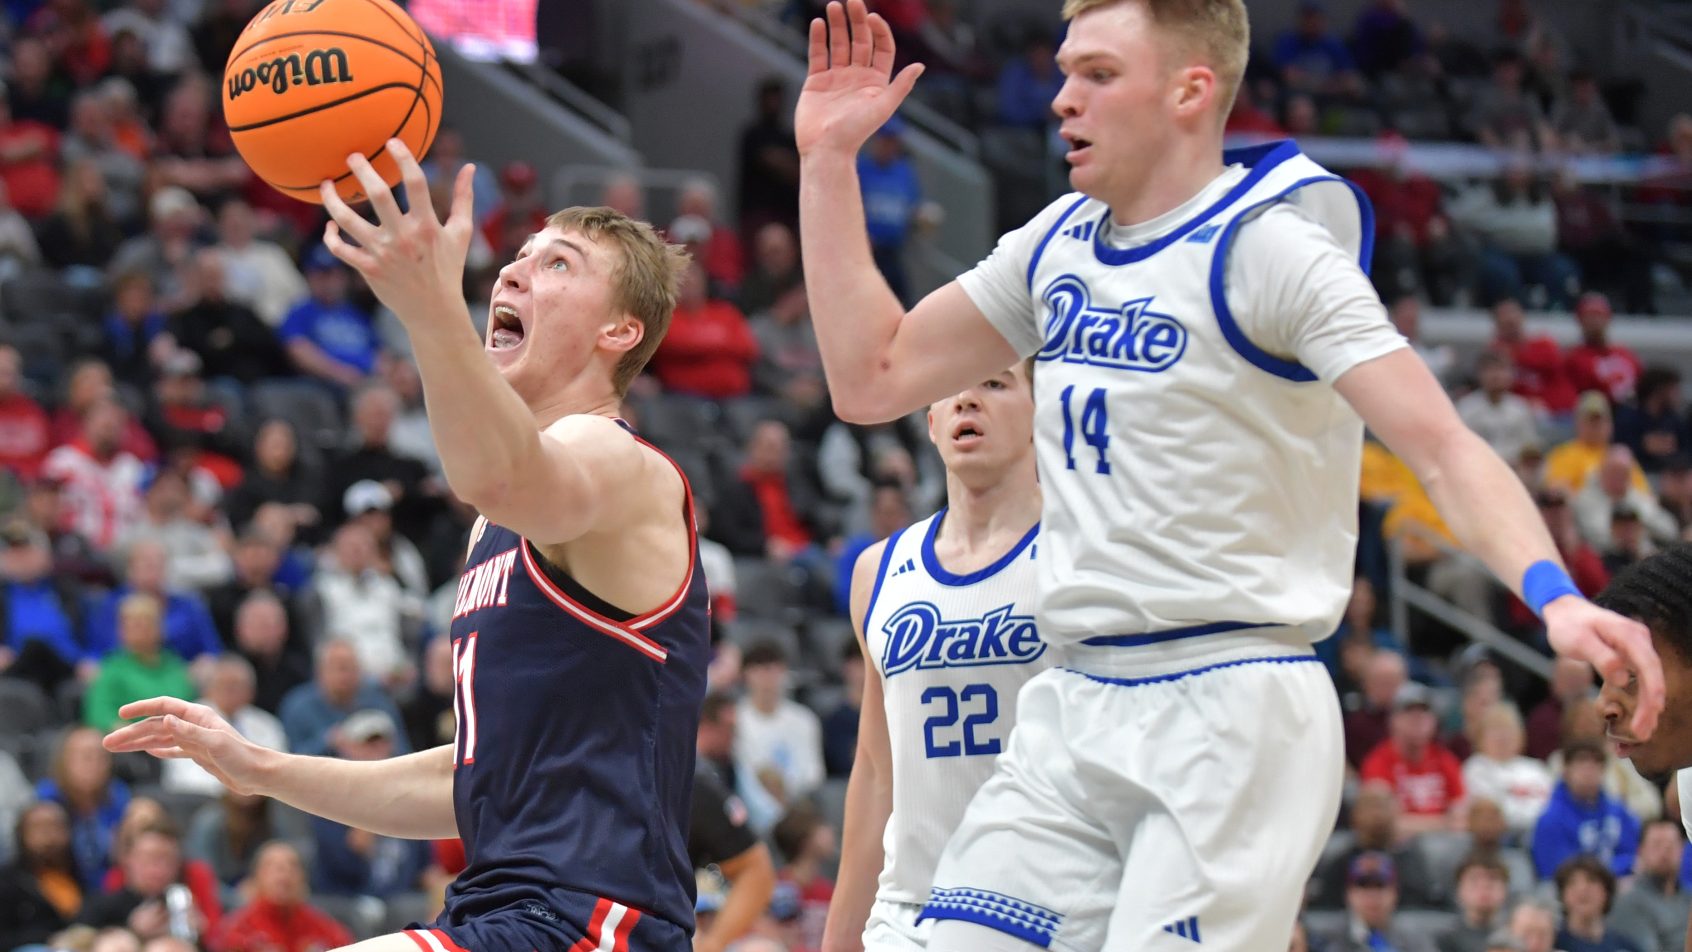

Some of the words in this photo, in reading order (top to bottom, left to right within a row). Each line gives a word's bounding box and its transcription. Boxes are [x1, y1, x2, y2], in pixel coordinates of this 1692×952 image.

[228, 47, 354, 101] Wilson
[1036, 274, 1187, 373] Drake
[1059, 384, 1112, 475] 14
[881, 601, 1048, 679] Drake
[920, 683, 1002, 759] 22
